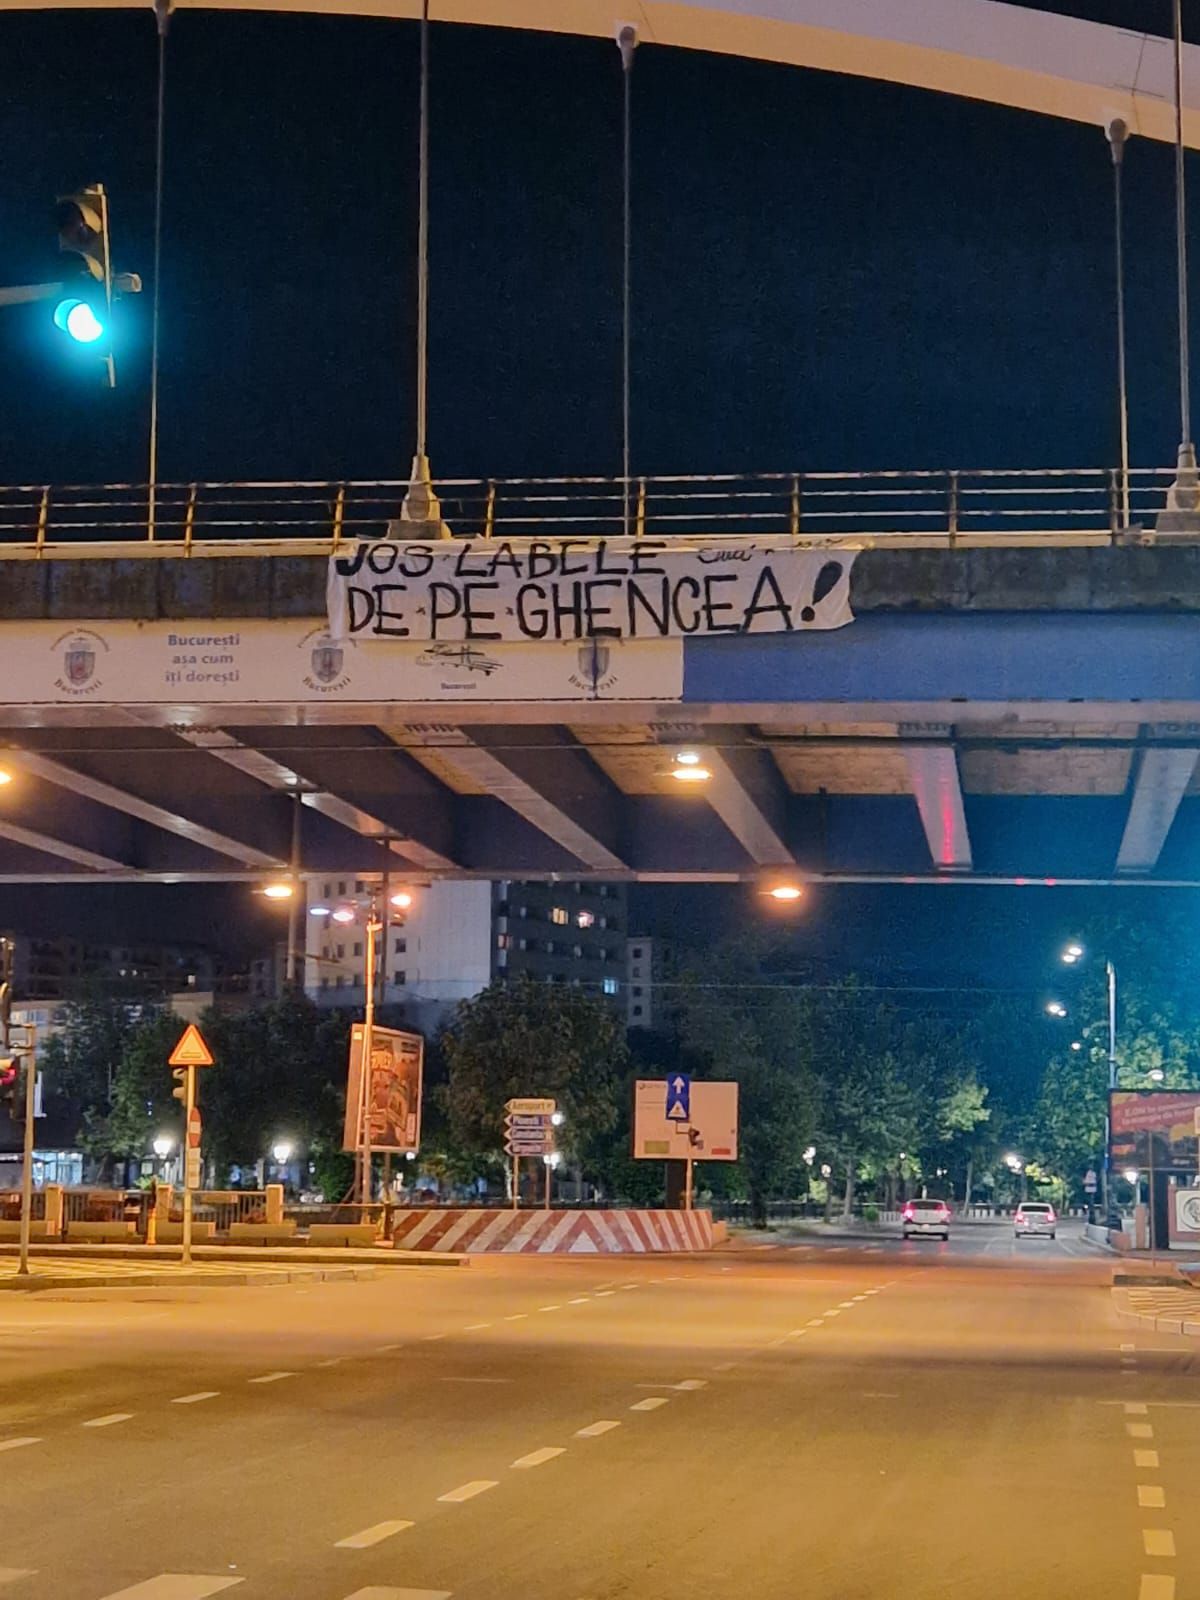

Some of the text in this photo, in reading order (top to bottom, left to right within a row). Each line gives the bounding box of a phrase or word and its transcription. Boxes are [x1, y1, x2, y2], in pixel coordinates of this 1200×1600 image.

[335, 542, 434, 577] JOS
[348, 560, 843, 640] DE PE GHENCEA!
[167, 633, 240, 650] București
[201, 655, 234, 664] cum
[185, 670, 240, 687] dorești
